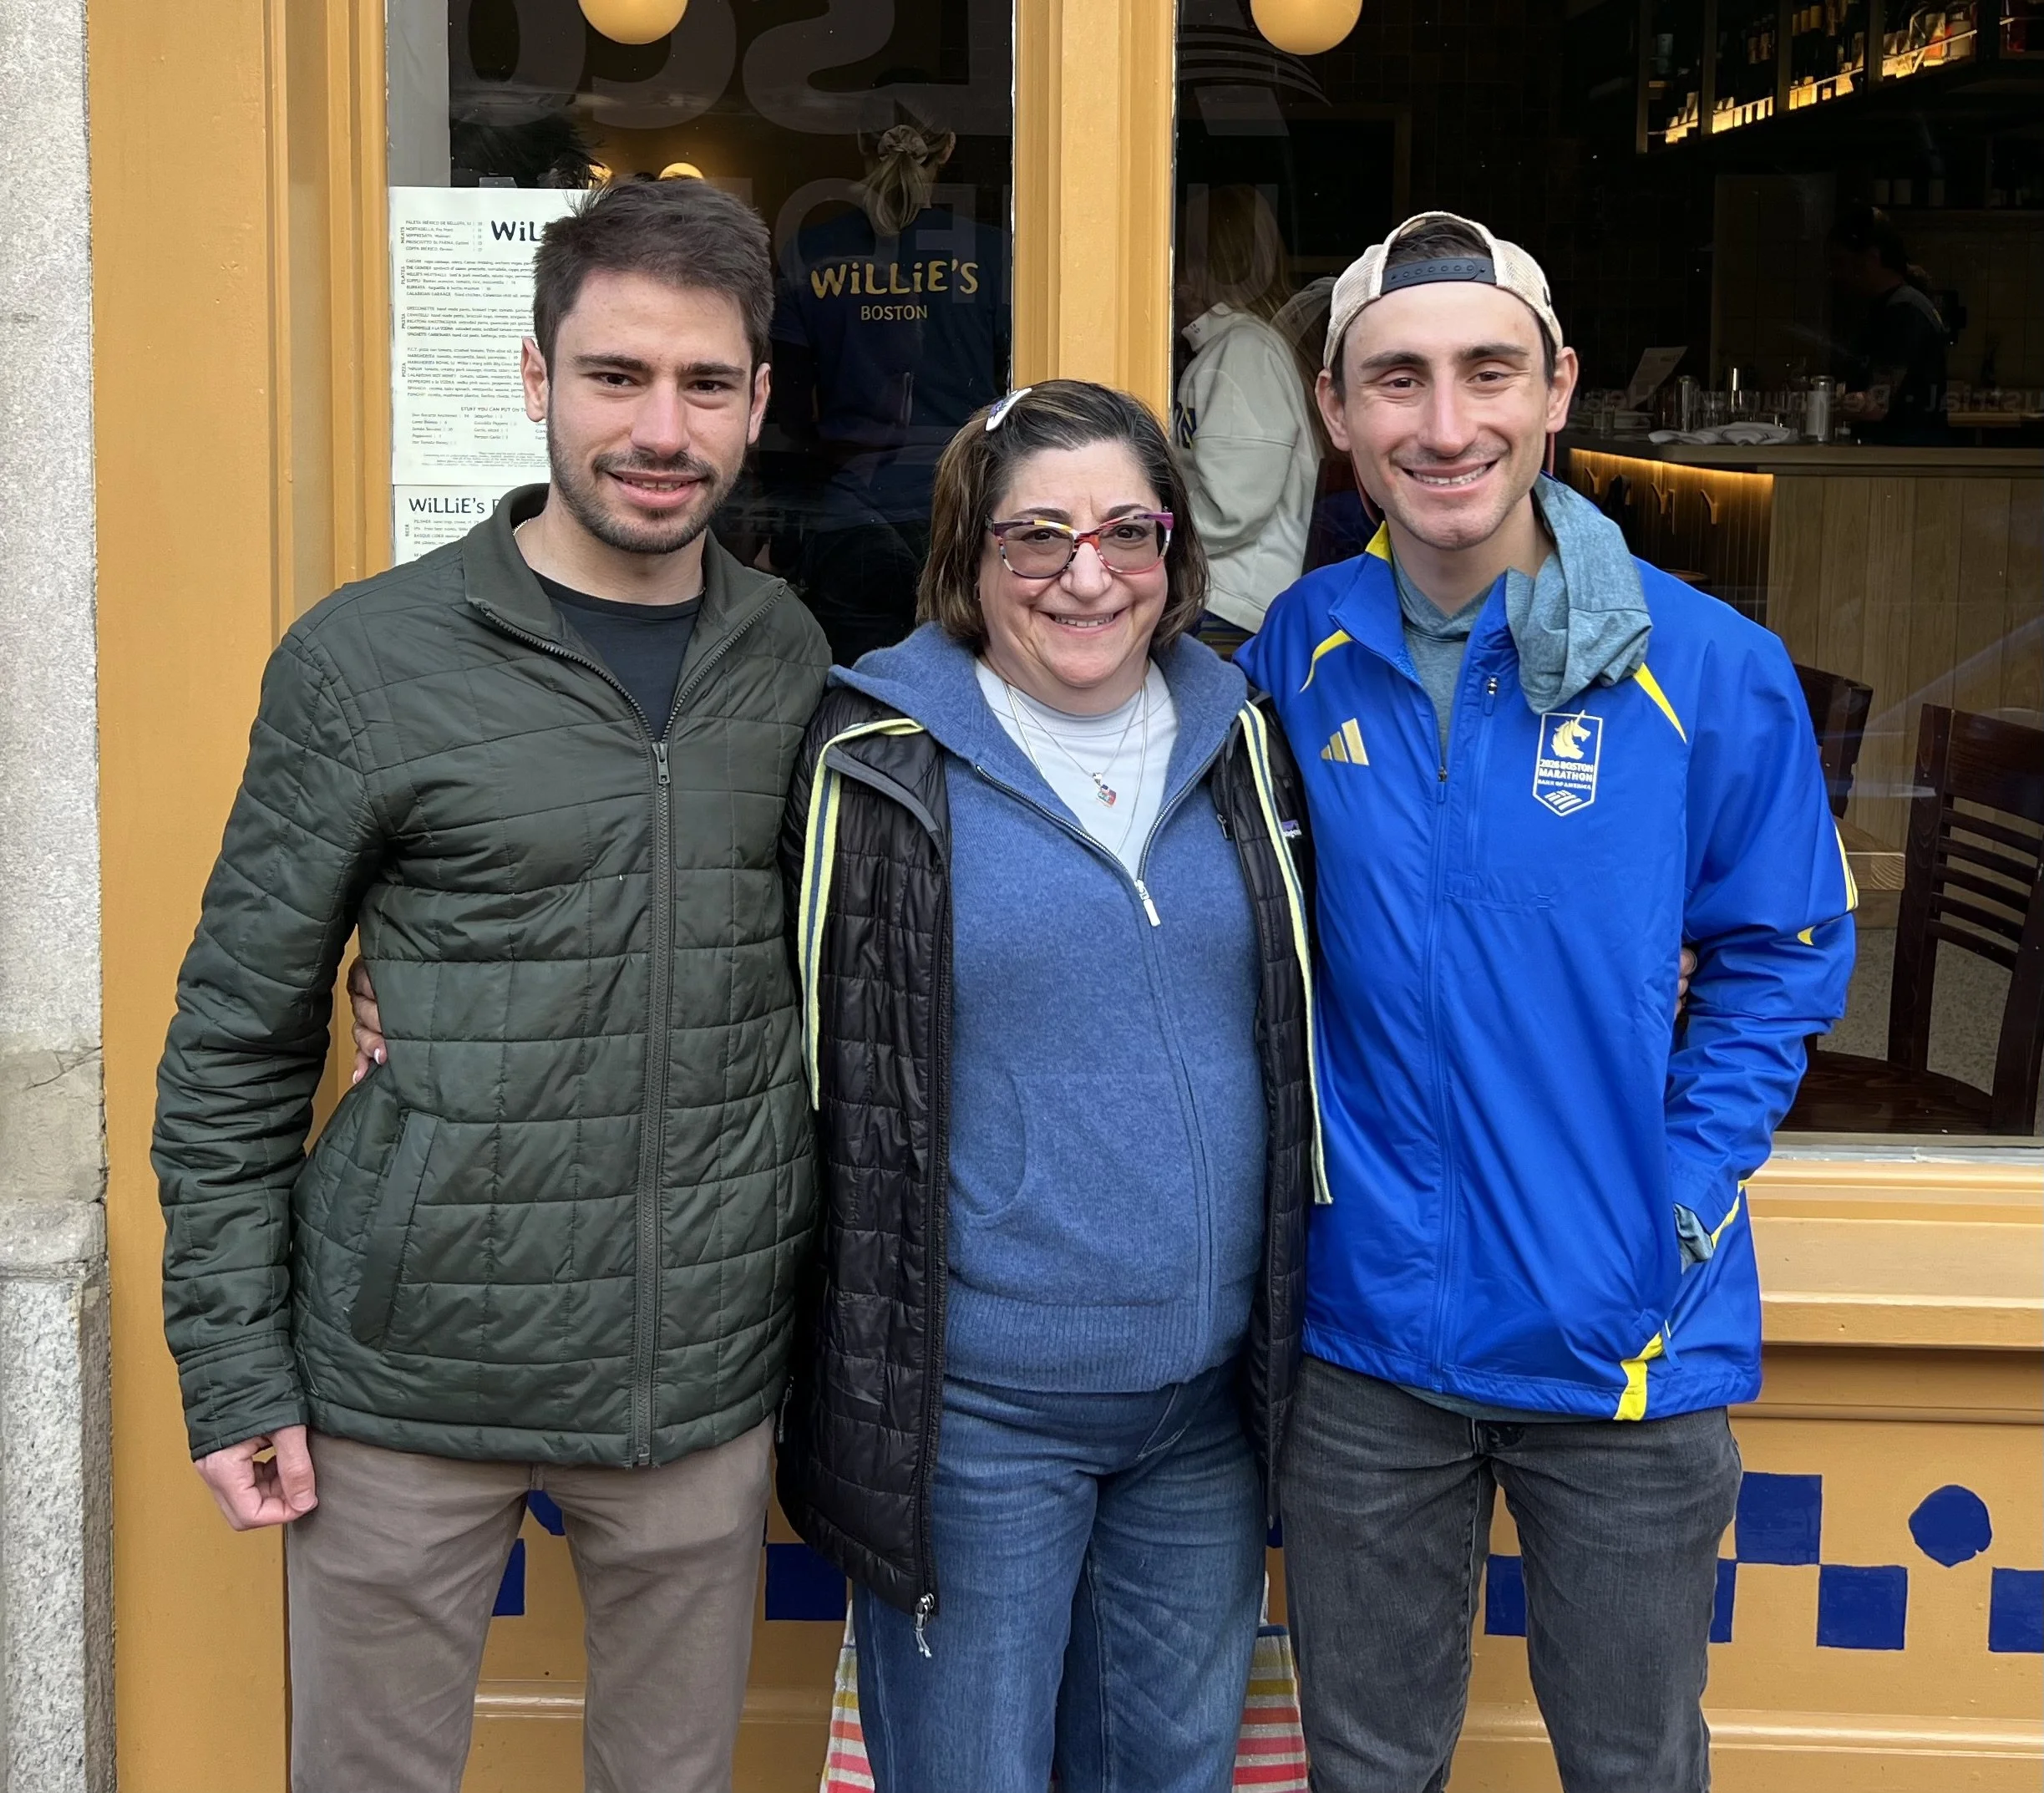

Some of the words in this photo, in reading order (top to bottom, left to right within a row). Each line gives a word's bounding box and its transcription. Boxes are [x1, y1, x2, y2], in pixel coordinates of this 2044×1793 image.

[861, 305, 928, 321] BOSTON
[1539, 767, 1594, 782] MARATHON
[1560, 761, 1594, 773] BOSTON
